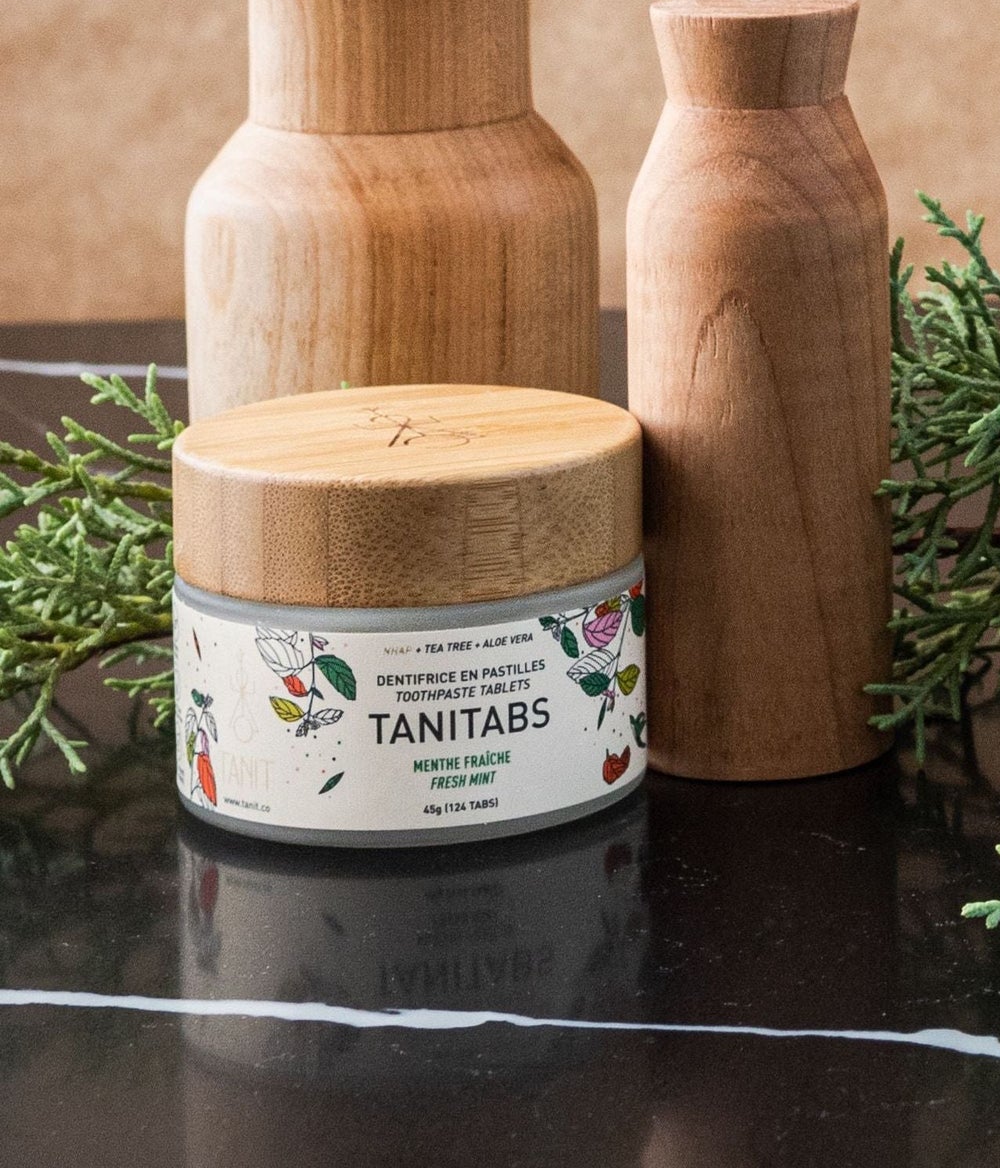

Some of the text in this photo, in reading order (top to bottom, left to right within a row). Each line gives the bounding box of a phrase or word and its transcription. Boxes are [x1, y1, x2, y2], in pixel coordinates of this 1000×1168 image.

[425, 644, 444, 654] TEA
[447, 641, 473, 652] TREE
[482, 636, 508, 648] ALOE
[510, 633, 533, 644] VERA
[377, 659, 546, 687] DENTIFRICE EN PASTILLES
[396, 679, 531, 703] TOOTHPASTE TABLETS
[368, 697, 550, 744] TANITABS
[413, 751, 511, 773] MENTHE FRAÎCHE
[430, 771, 497, 790] FRESH MINT
[223, 796, 271, 813] www.tanit.co
[423, 798, 499, 815] 45g (124 TABS)
